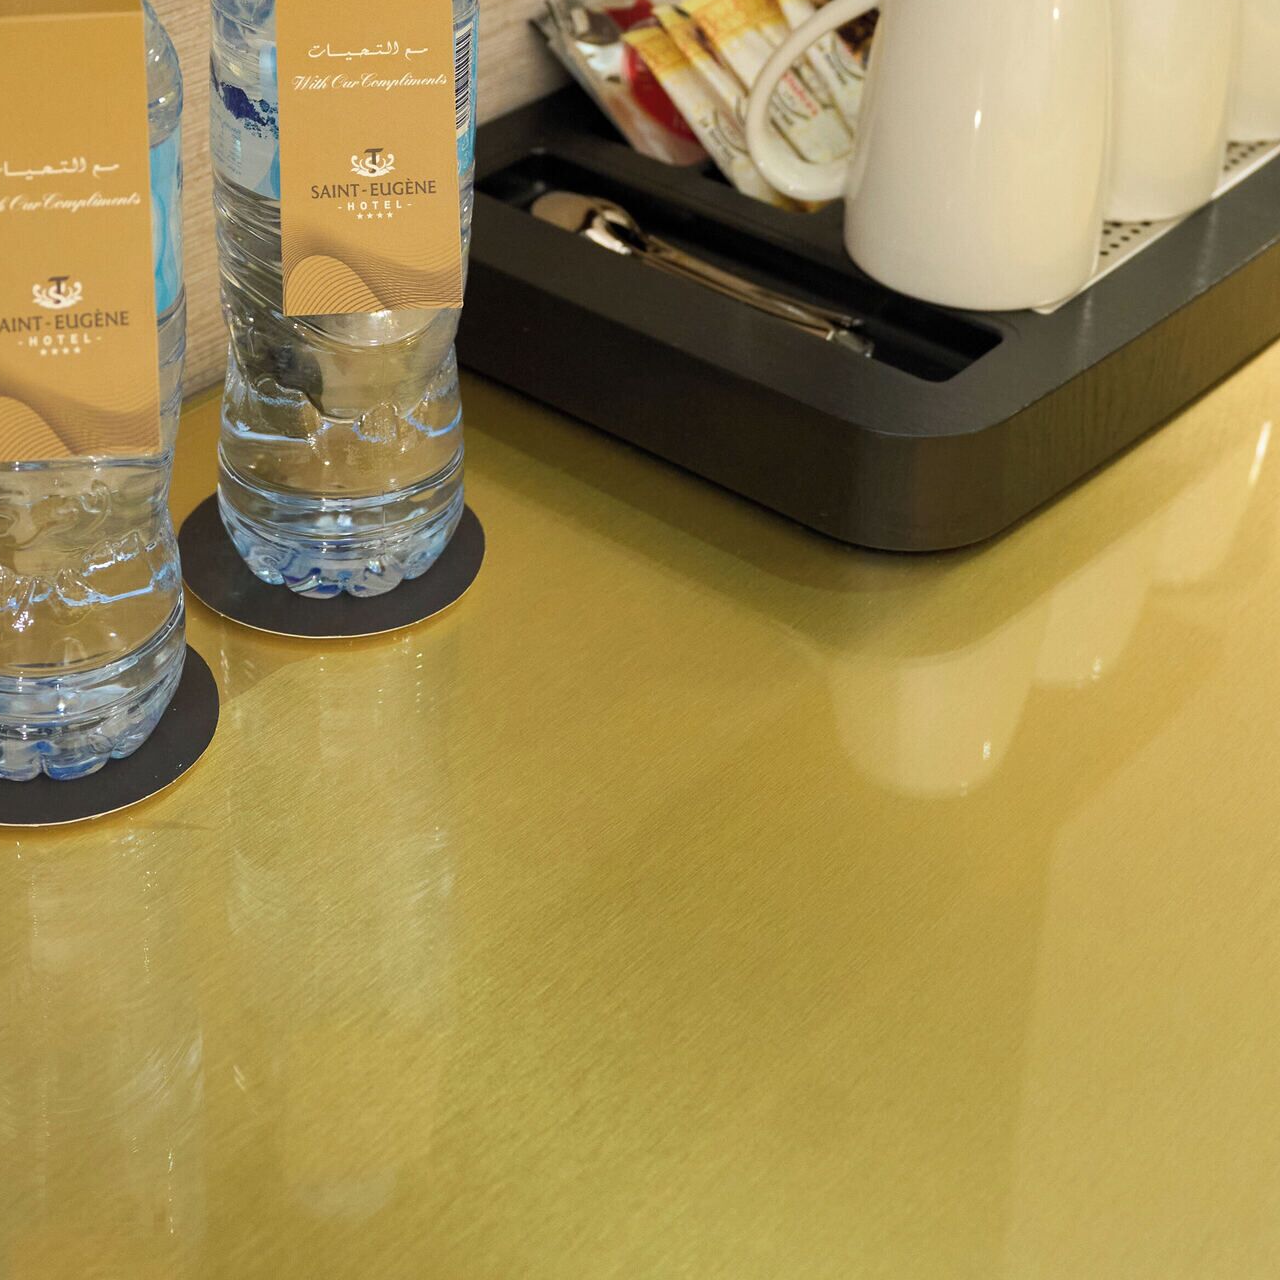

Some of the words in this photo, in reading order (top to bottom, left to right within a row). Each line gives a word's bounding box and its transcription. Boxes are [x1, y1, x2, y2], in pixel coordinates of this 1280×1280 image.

[308, 40, 399, 61] التحيات
[292, 74, 328, 91] With
[331, 74, 360, 89] Our
[360, 72, 448, 91] Compliments
[9, 195, 42, 212] Our
[42, 191, 141, 213] Compliments
